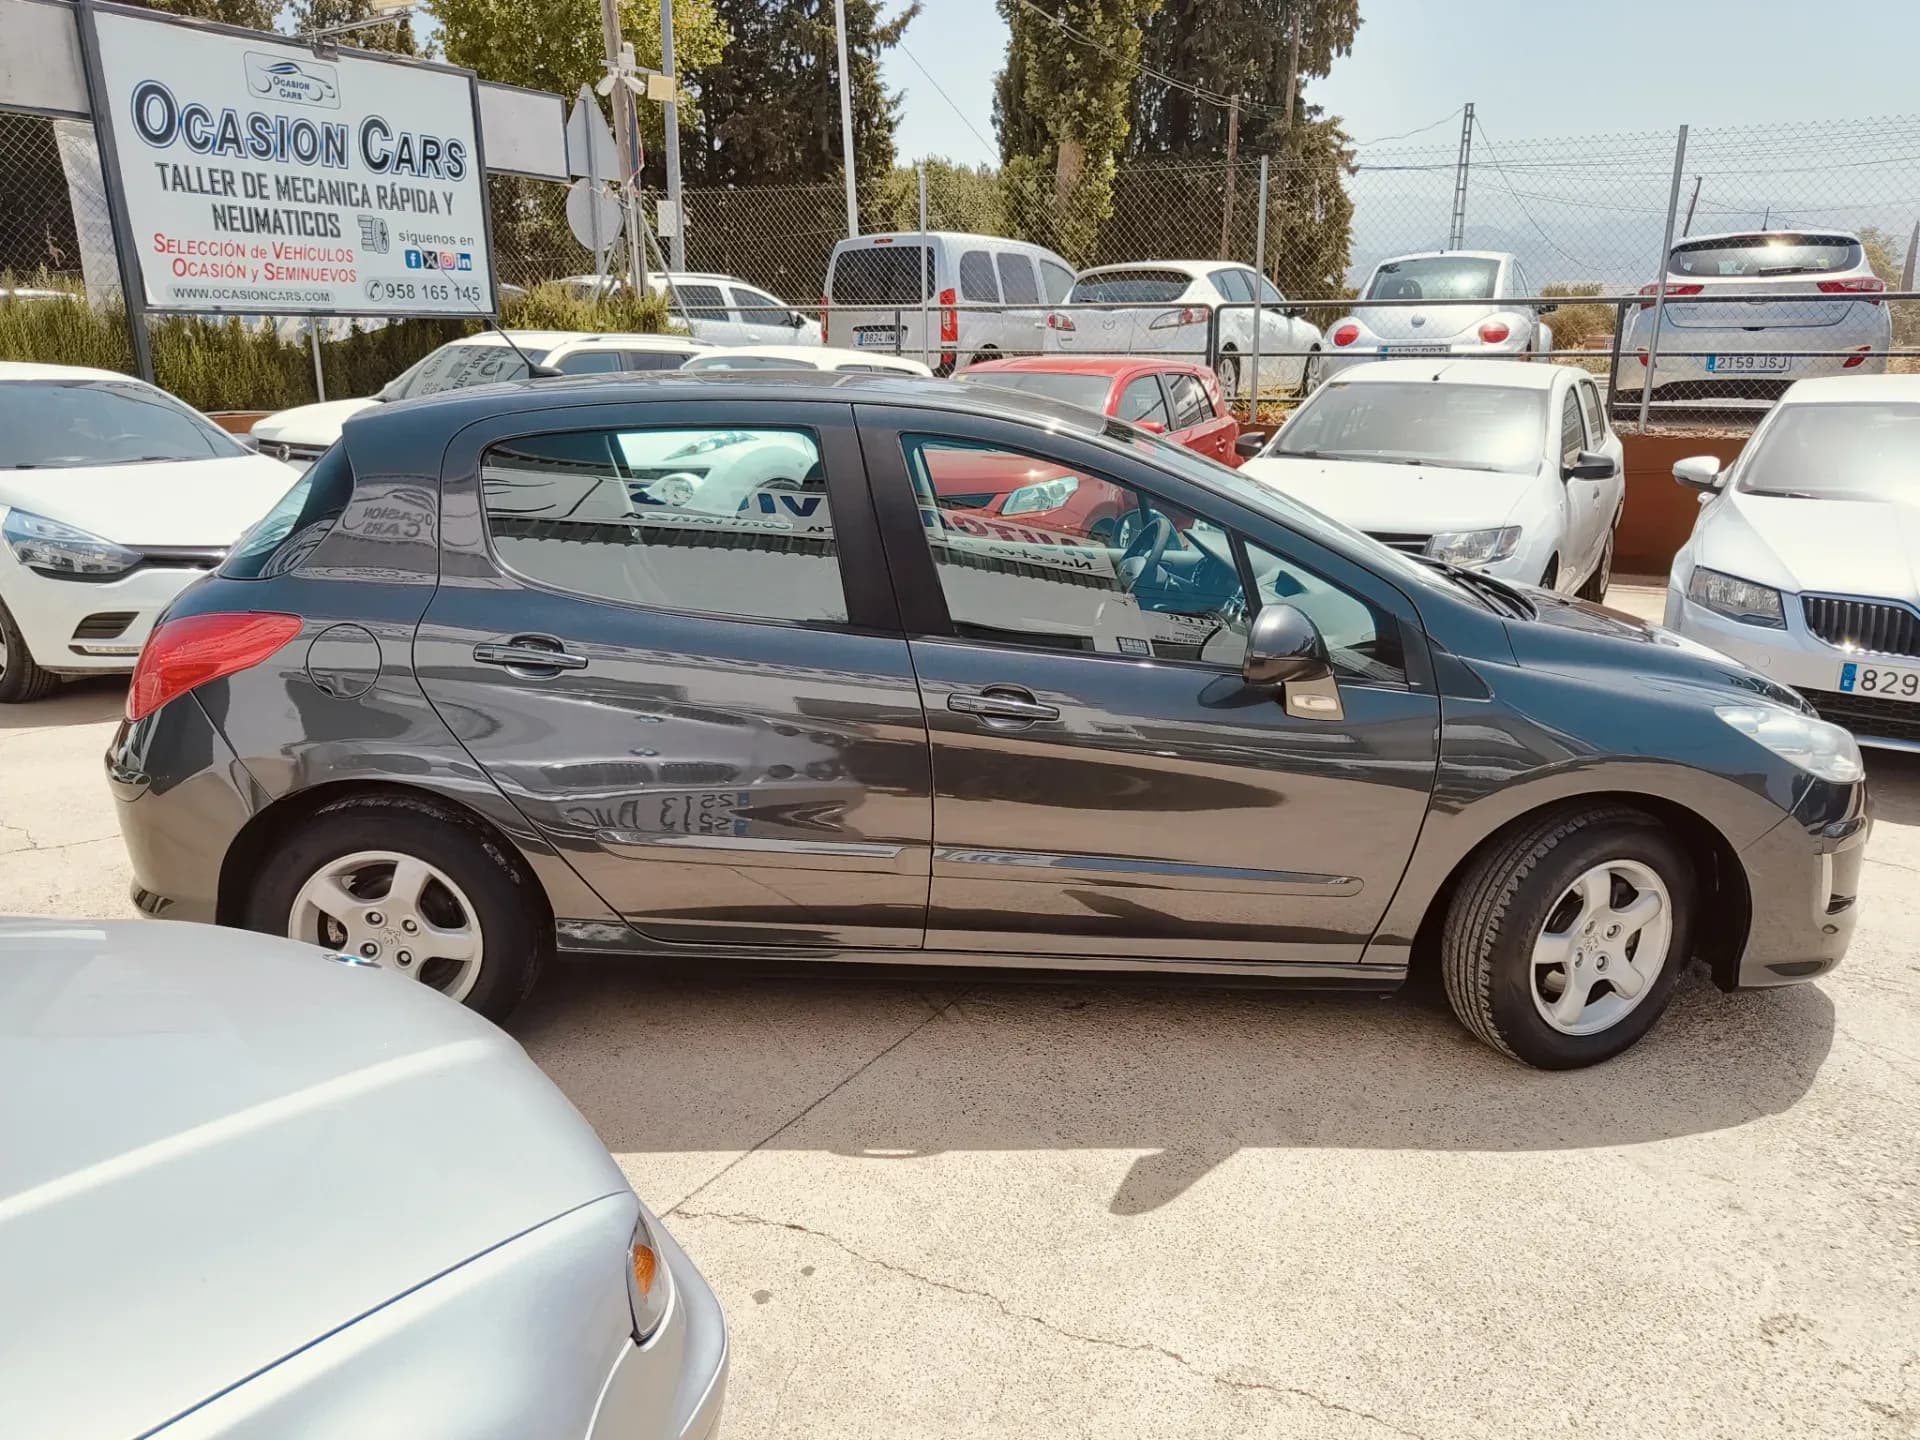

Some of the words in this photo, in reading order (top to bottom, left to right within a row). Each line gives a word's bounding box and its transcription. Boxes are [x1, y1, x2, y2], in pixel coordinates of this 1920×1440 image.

[273, 75, 310, 90] OCASION
[279, 88, 302, 100] CARS
[131, 80, 349, 169] OCASION
[358, 115, 467, 182] CARS
[154, 162, 238, 198] TALLER
[241, 171, 270, 200] DE
[274, 174, 372, 208] MECANICA
[376, 181, 439, 215] RÁPIDA
[443, 191, 454, 216] Y
[211, 203, 342, 239] NEUMATICOS
[153, 232, 246, 258] SELECCIÓN
[250, 245, 267, 259] de
[271, 241, 354, 263] VEHÍCULOS
[459, 236, 475, 246] en
[172, 257, 247, 279] OCASIÓN
[251, 269, 260, 283] y
[263, 262, 357, 283] SEMINUEVOS
[173, 287, 331, 302] WWW.OCASIONCARS.COM
[385, 282, 415, 299] 958
[421, 284, 448, 300] 165
[454, 286, 481, 301] 145
[1717, 356, 1754, 369] 2159
[1759, 355, 1787, 369] JSJ
[1860, 669, 1919, 697] 829
